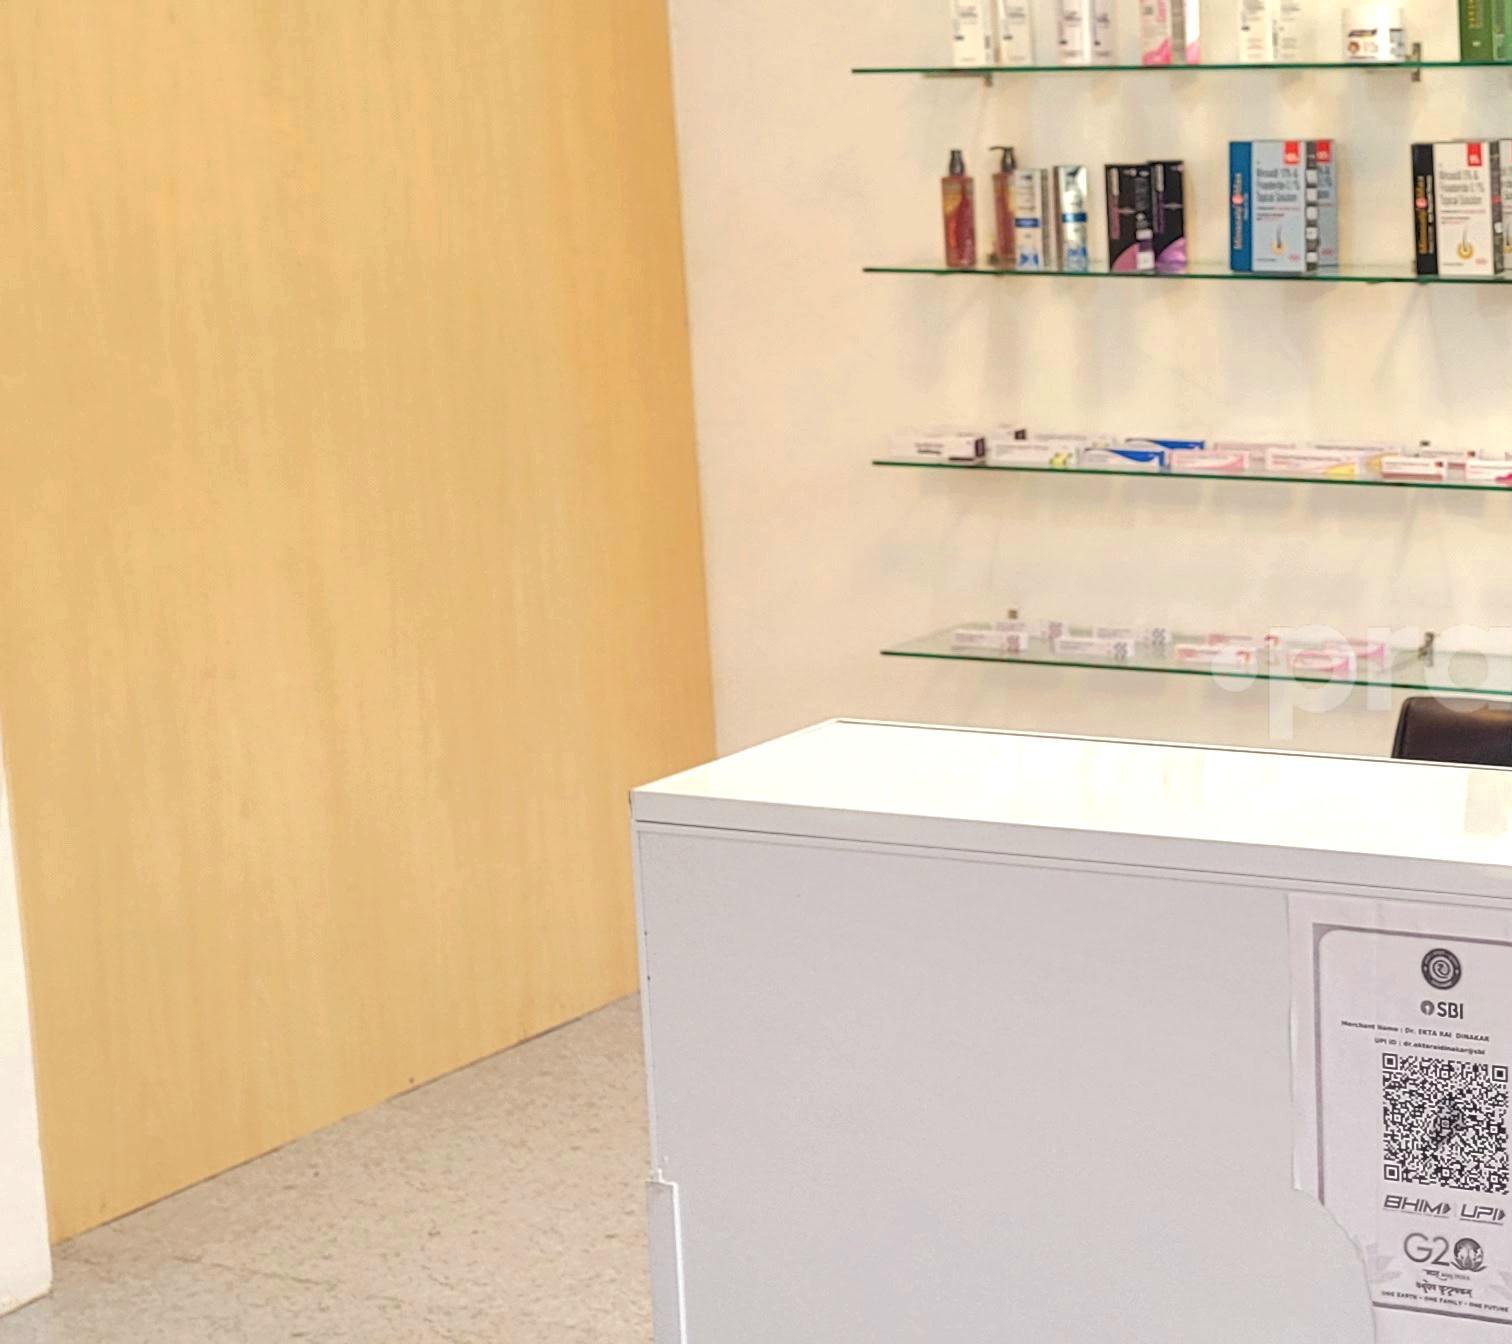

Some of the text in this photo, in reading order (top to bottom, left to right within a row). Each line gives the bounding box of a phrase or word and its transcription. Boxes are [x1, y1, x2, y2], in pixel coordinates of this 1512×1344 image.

[1437, 1001, 1463, 1019] SBI
[1341, 1020, 1375, 1030] Merchant
[1418, 1028, 1437, 1037] EKTA
[1384, 1195, 1499, 1221] BHIM UPI
